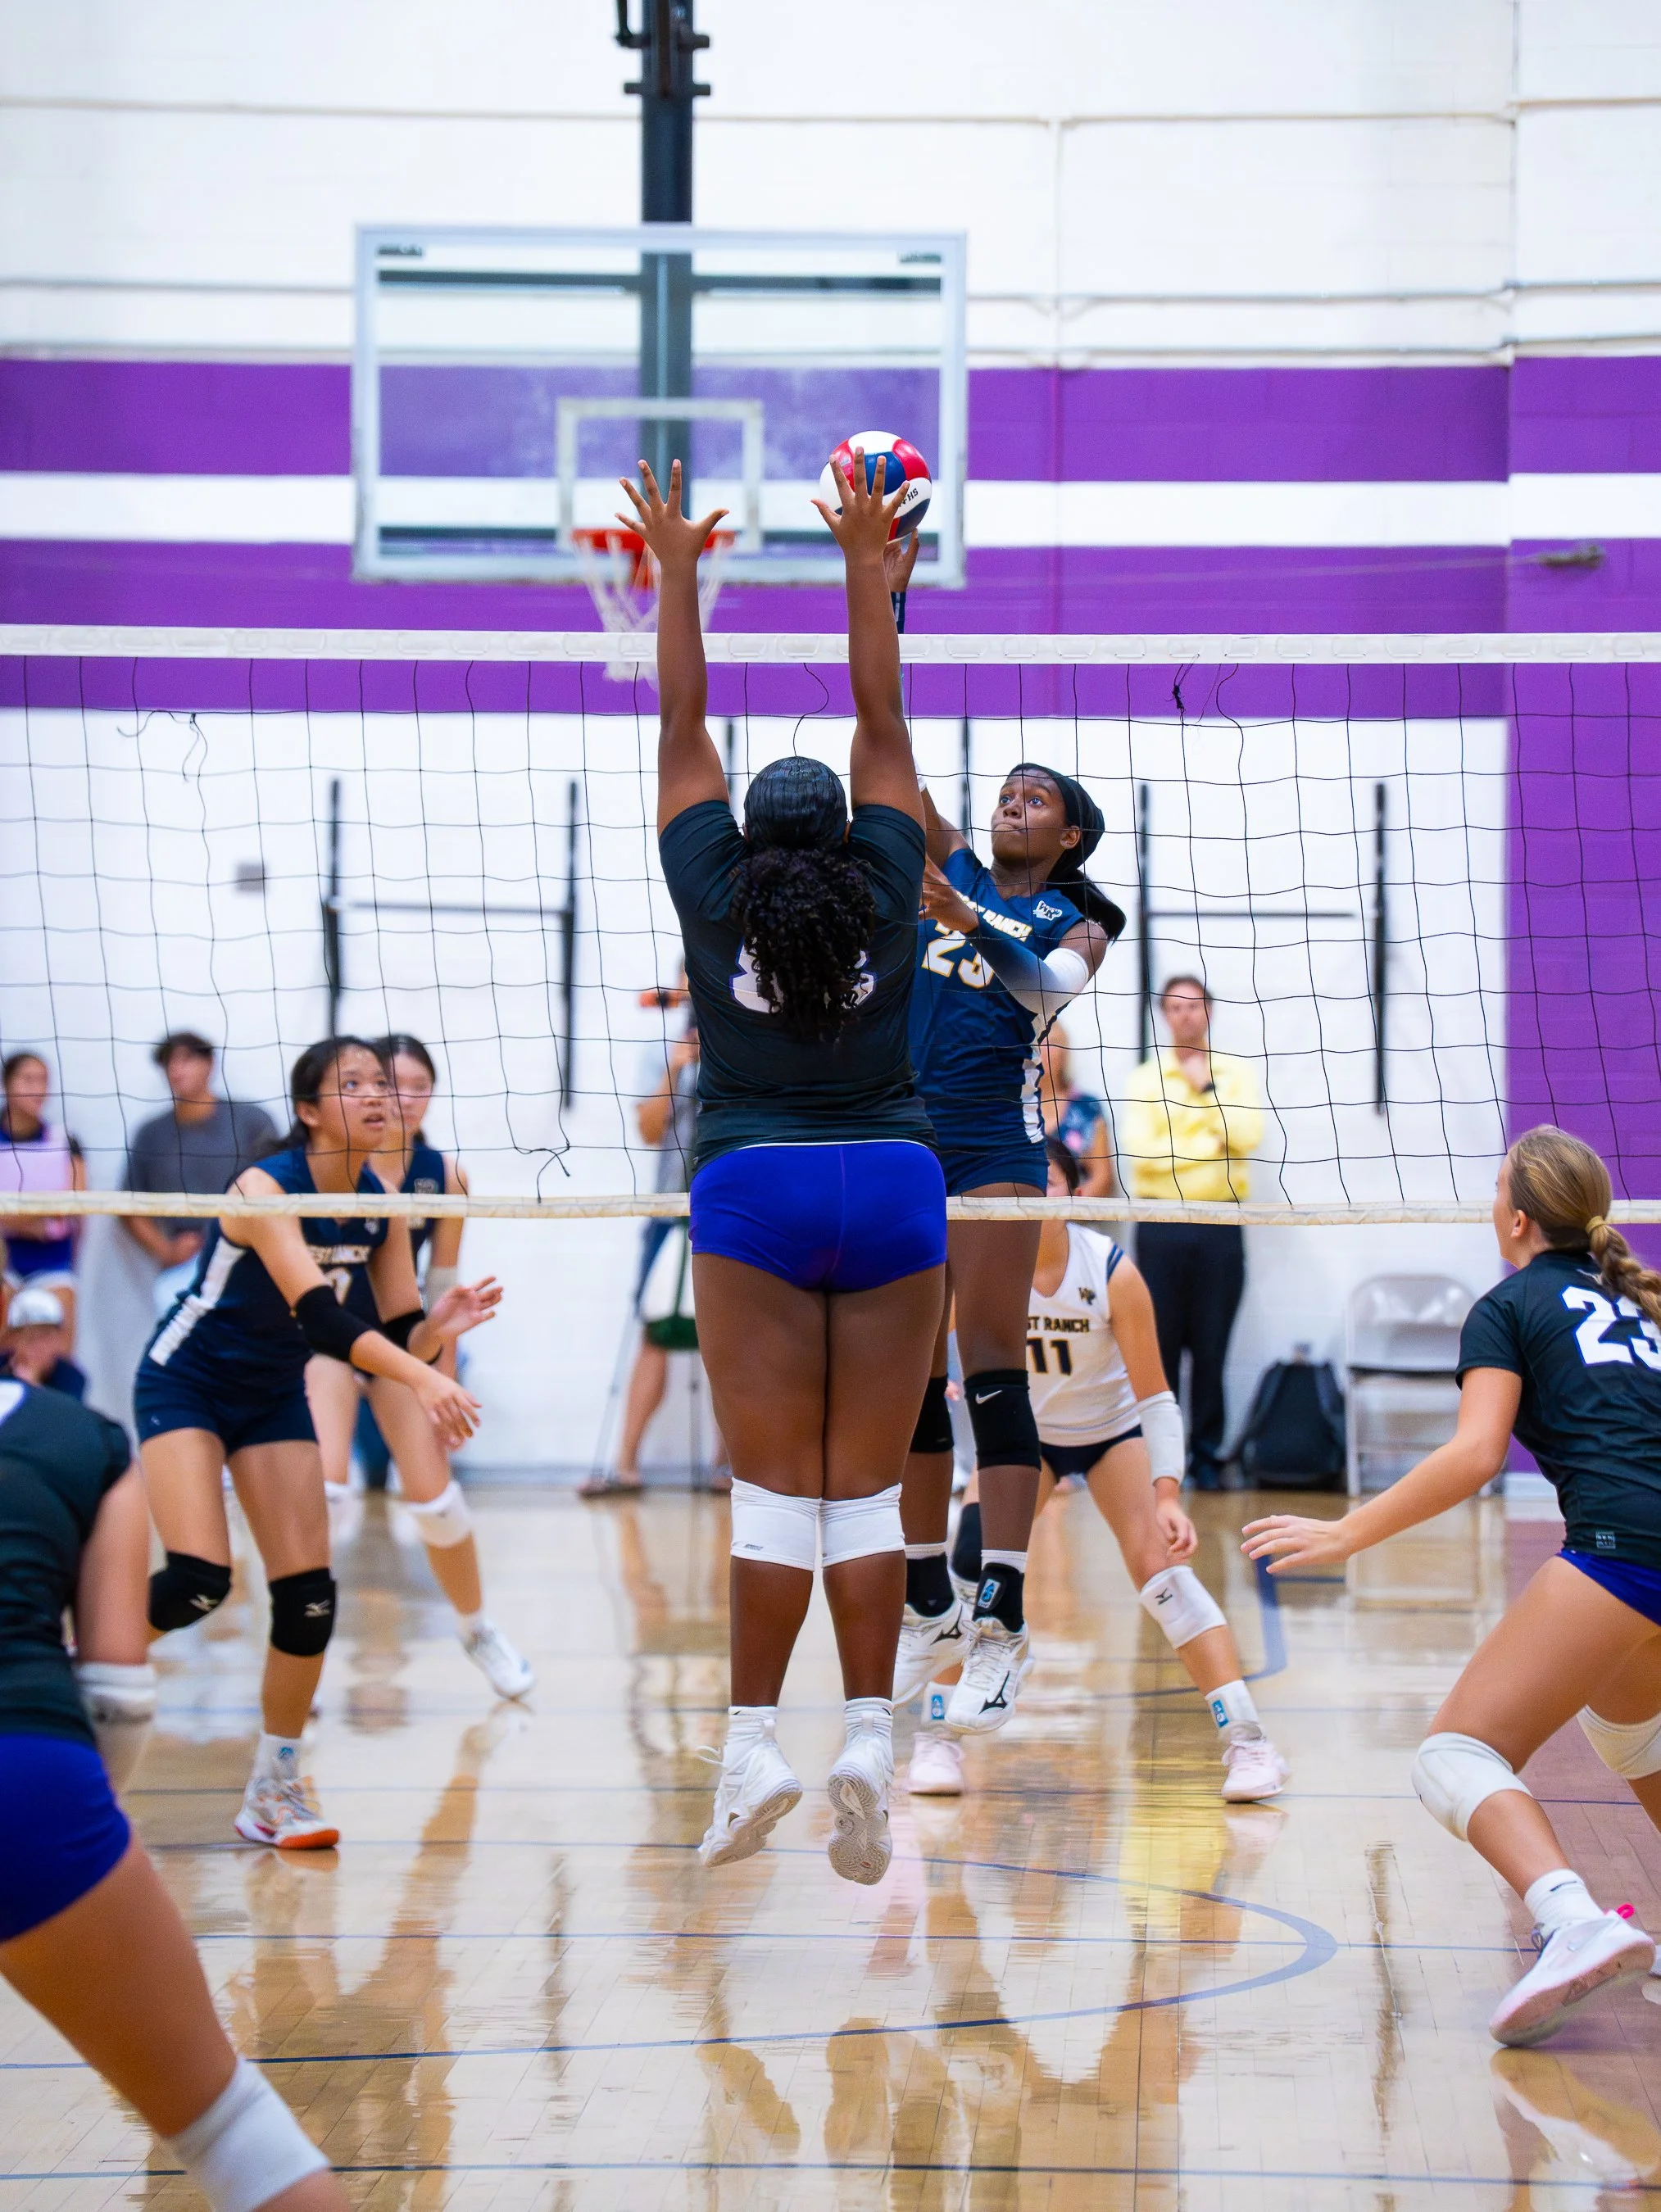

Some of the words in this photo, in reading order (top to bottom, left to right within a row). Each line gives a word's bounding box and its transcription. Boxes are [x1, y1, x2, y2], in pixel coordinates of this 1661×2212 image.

[898, 487, 919, 507] FHS
[983, 909, 1032, 942] RANCH
[1043, 1317, 1090, 1333] RANCH
[1559, 1284, 1661, 1374] 23
[1026, 1336, 1073, 1376] 11
